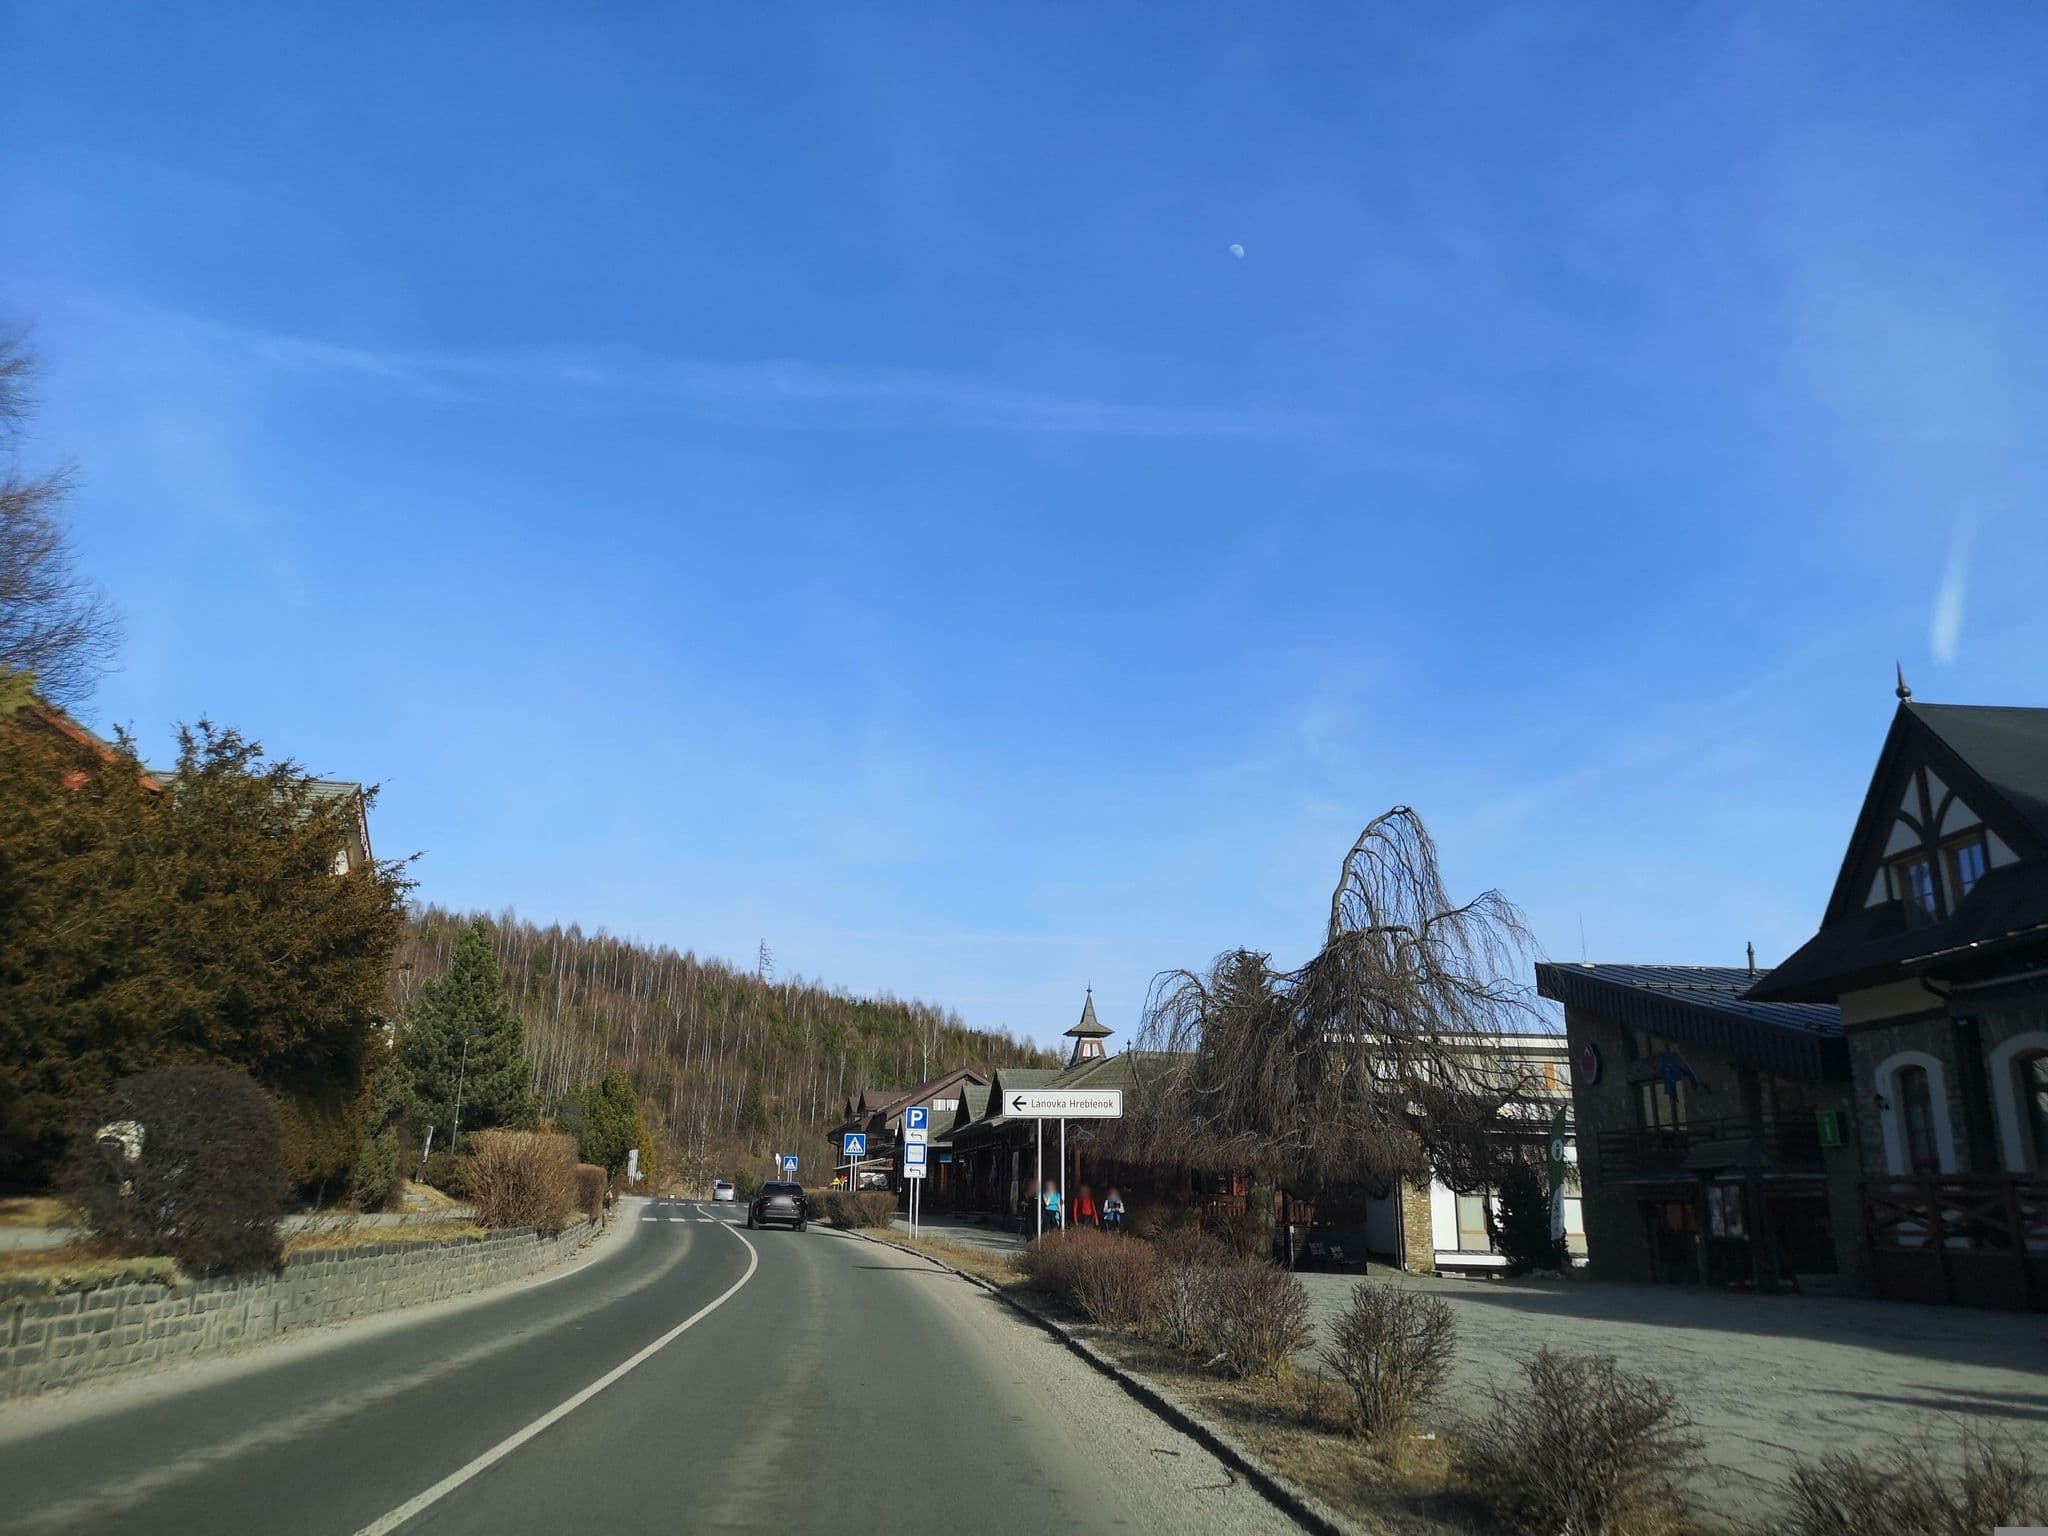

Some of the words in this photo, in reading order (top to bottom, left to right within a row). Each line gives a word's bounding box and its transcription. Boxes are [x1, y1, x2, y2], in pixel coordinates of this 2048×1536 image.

[1031, 1099, 1067, 1109] Lanovka
[1069, 1098, 1114, 1109] Hrebienok
[911, 1110, 923, 1127] P
